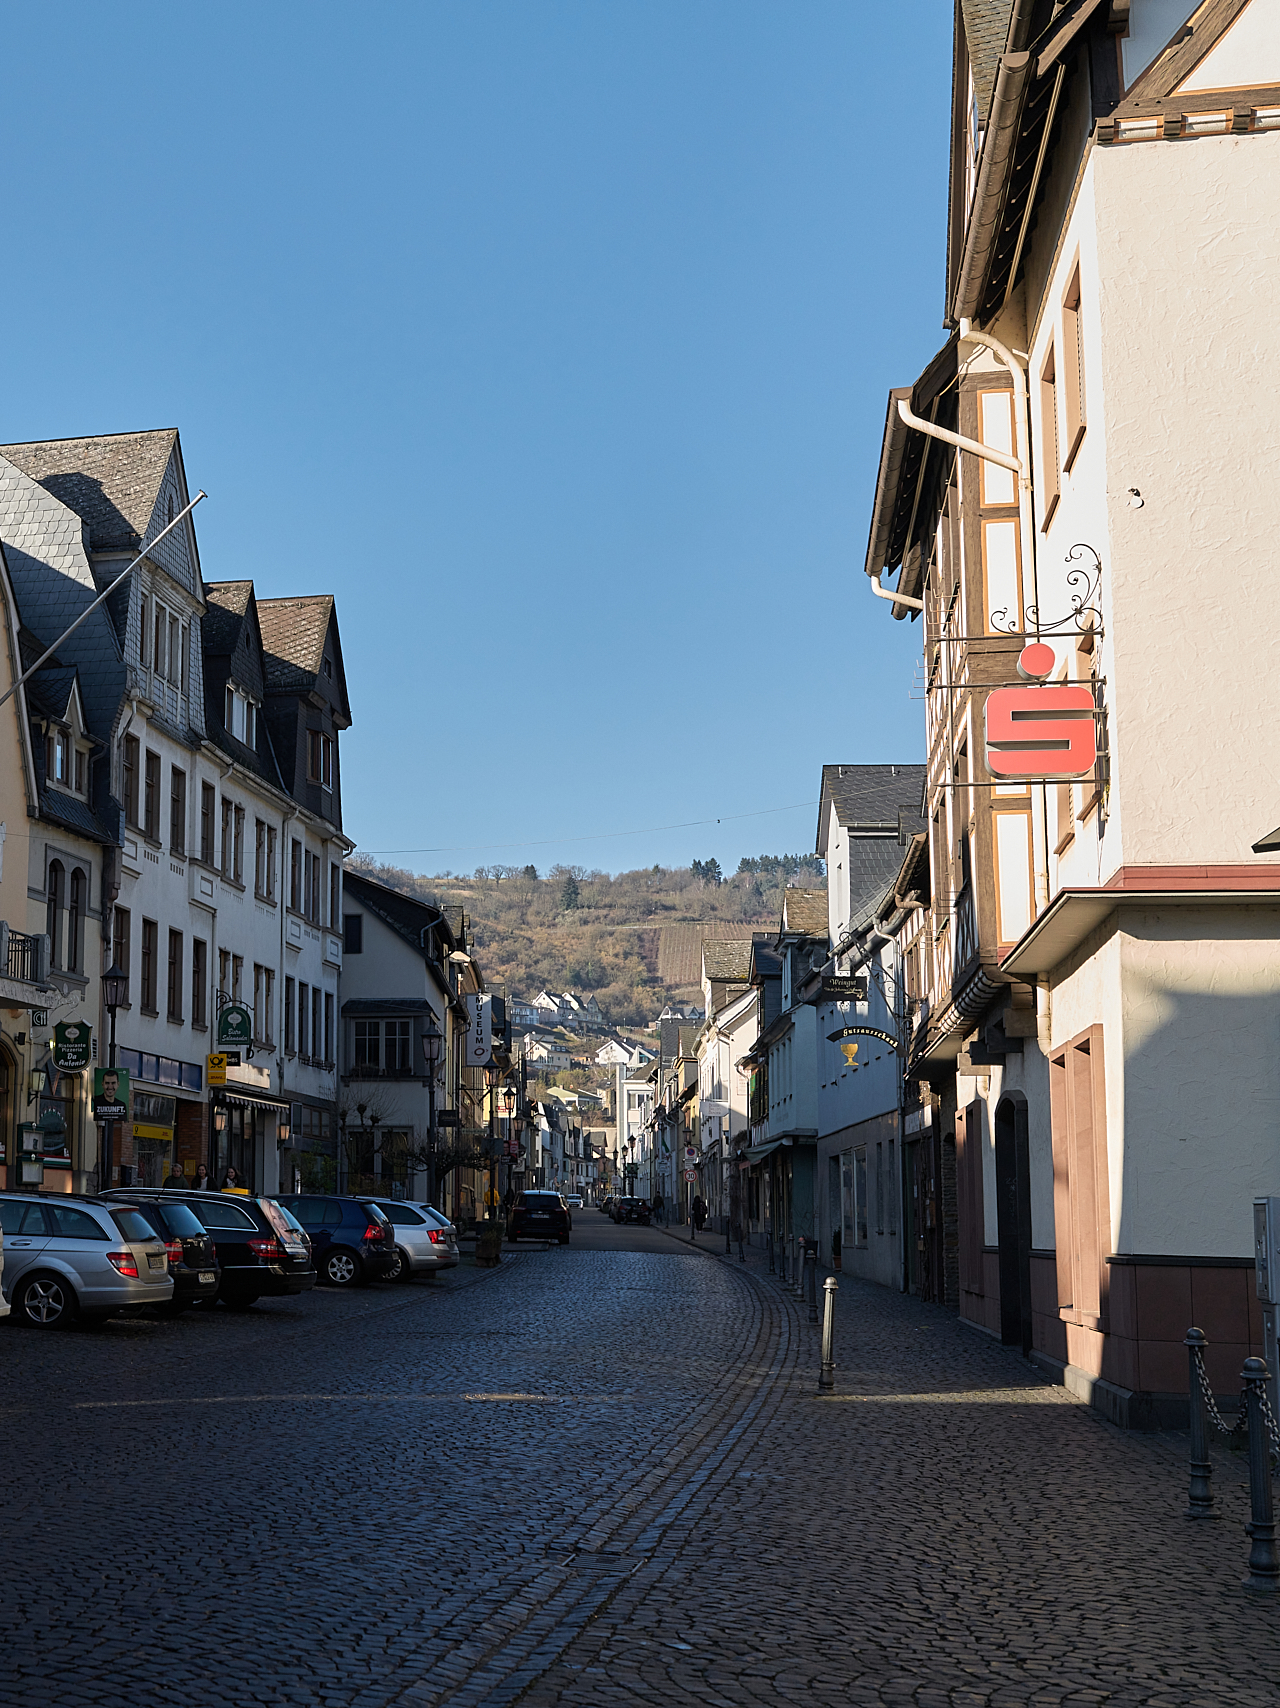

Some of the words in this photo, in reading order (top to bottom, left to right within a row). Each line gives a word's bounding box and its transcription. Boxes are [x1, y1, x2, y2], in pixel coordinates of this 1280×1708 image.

[829, 978, 857, 988] Weingut
[476, 997, 484, 1043] MUSEUM
[843, 1028, 899, 1048] Gutsausschank
[67, 1052, 78, 1060] Da
[58, 1058, 87, 1067] Antonio
[687, 1172, 695, 1180] 30
